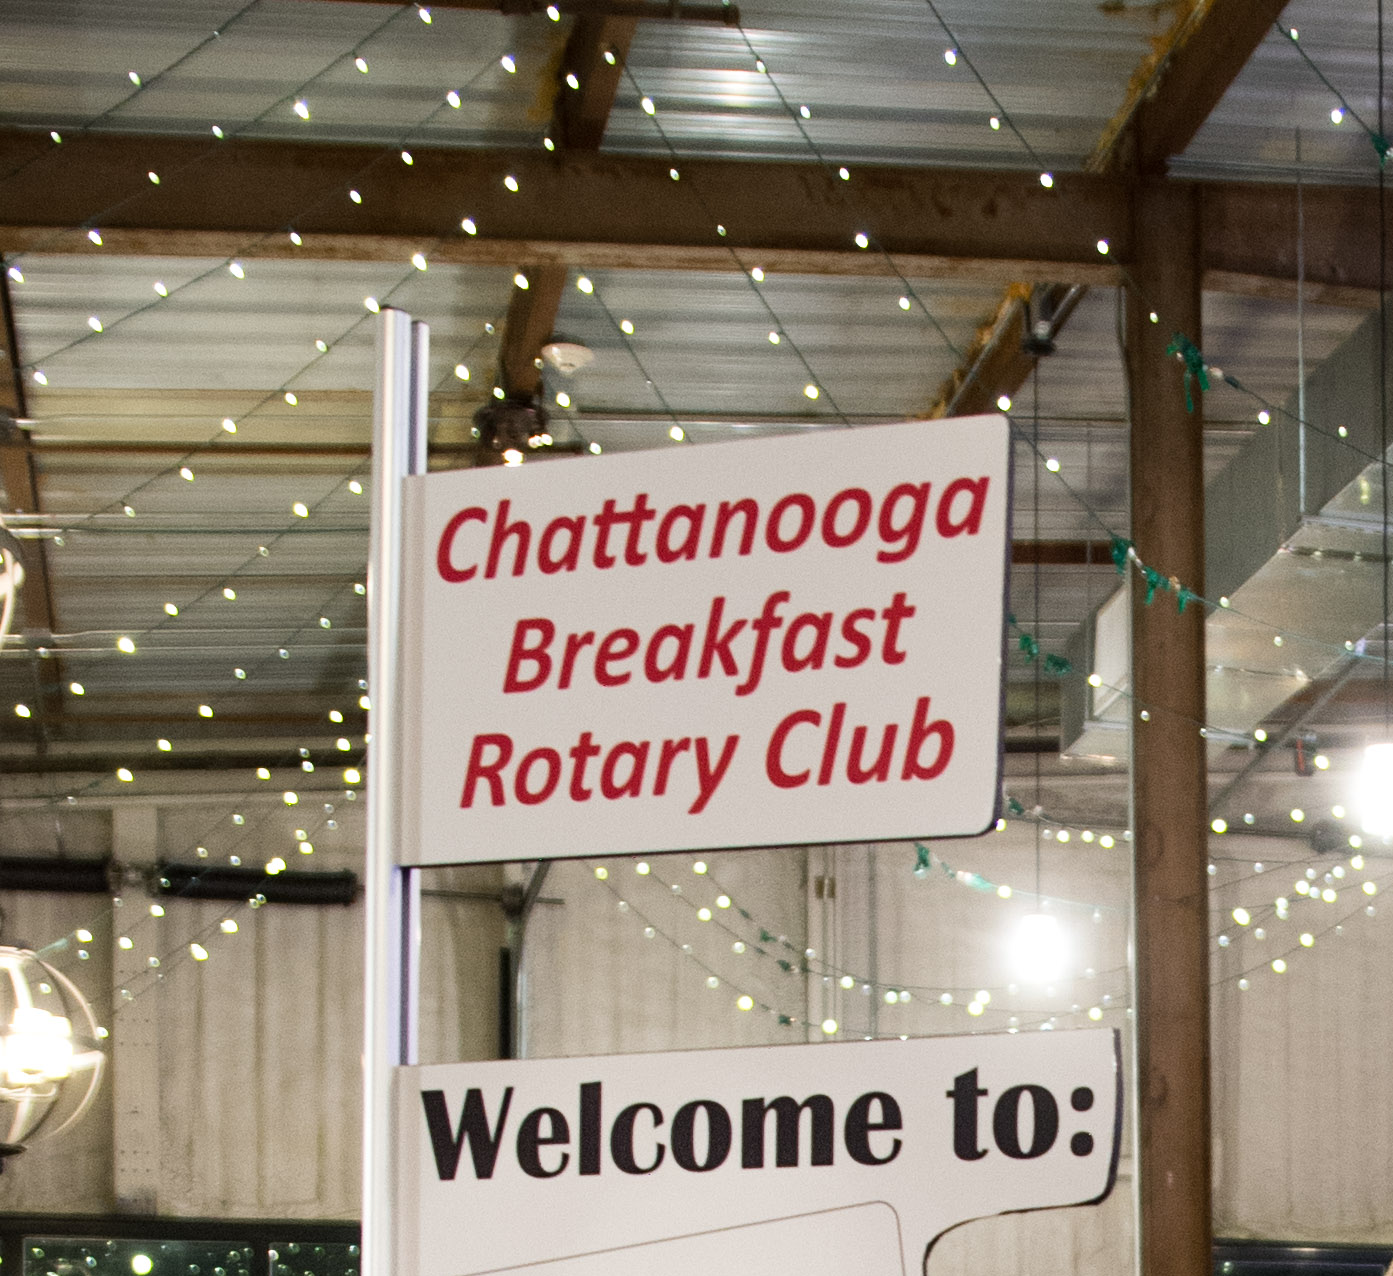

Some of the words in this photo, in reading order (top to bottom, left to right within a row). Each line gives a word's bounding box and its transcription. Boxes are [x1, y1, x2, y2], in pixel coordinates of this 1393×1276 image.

[436, 474, 990, 583] Chattanooga
[503, 592, 915, 696] Breakfast
[460, 727, 740, 815] Rotary
[765, 697, 956, 790] Club
[420, 1082, 903, 1182] Welcome
[946, 1067, 1096, 1162] to:
